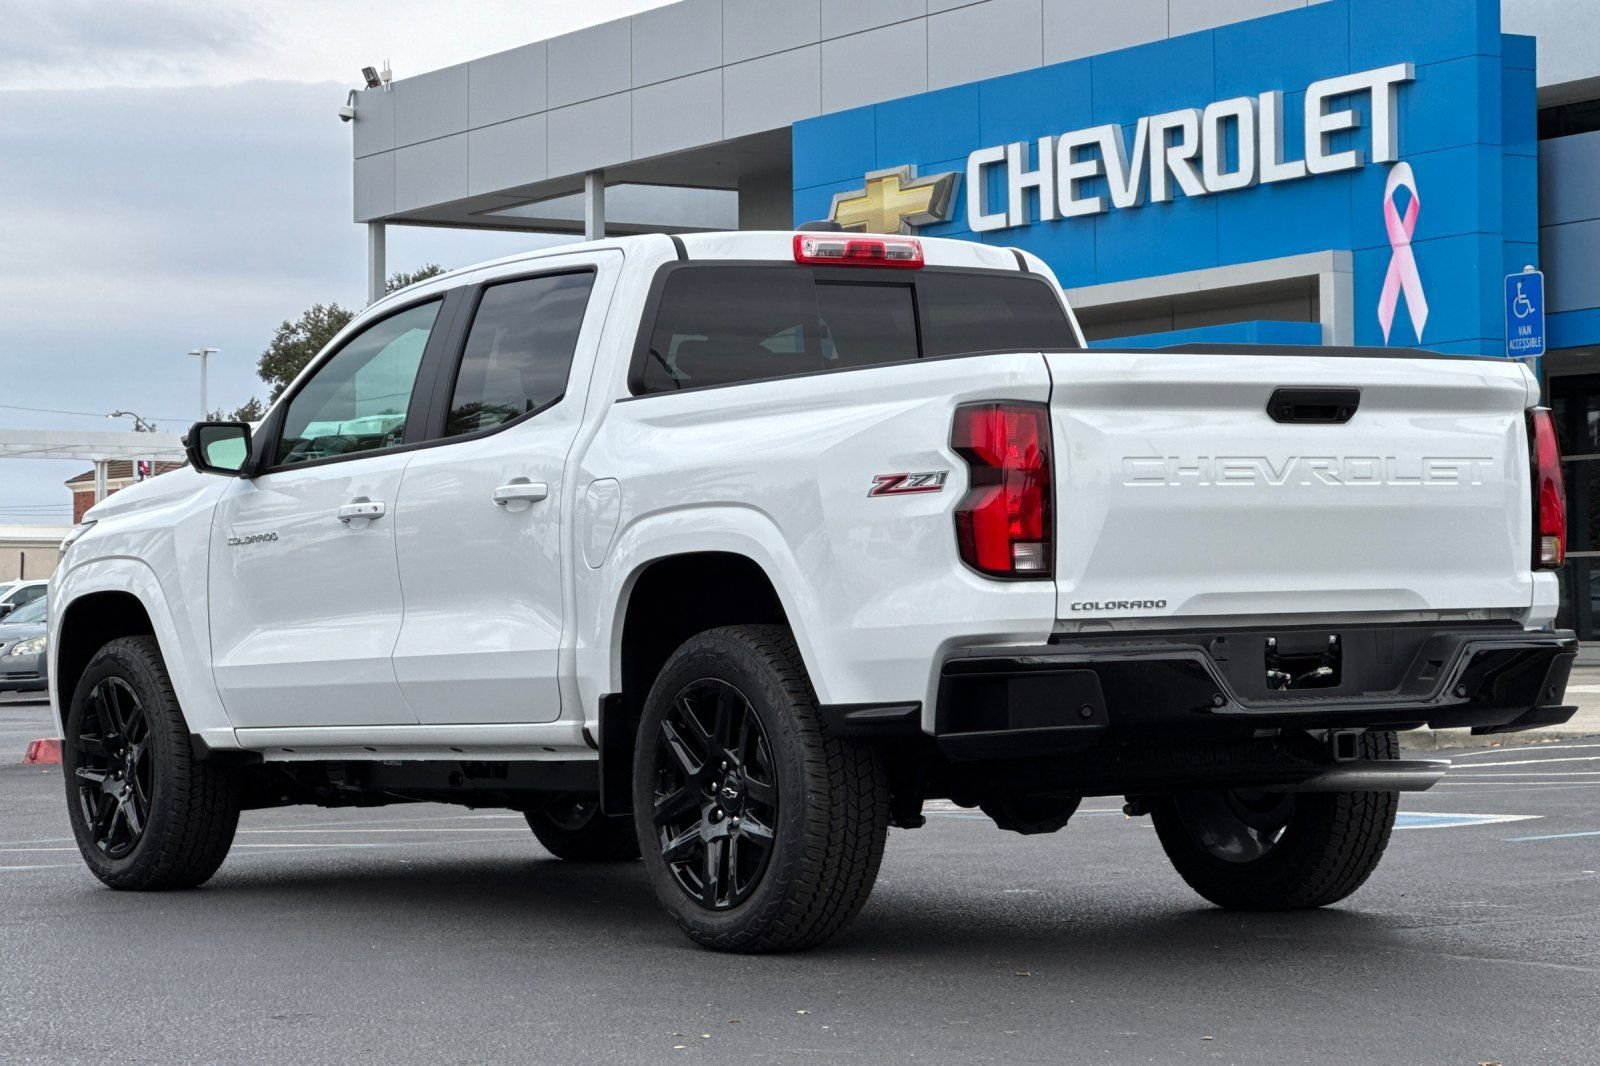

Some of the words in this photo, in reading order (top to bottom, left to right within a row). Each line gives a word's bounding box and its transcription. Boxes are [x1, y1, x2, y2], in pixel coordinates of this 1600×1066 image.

[967, 62, 1415, 233] CHEVROLET
[1518, 325, 1532, 336] VAN
[1509, 336, 1542, 350] ACCESSIBLE
[1122, 456, 1495, 486] CHEVROLET
[867, 470, 950, 498] Z71
[228, 532, 278, 546] COLORADO
[1071, 600, 1167, 611] COLORADO
